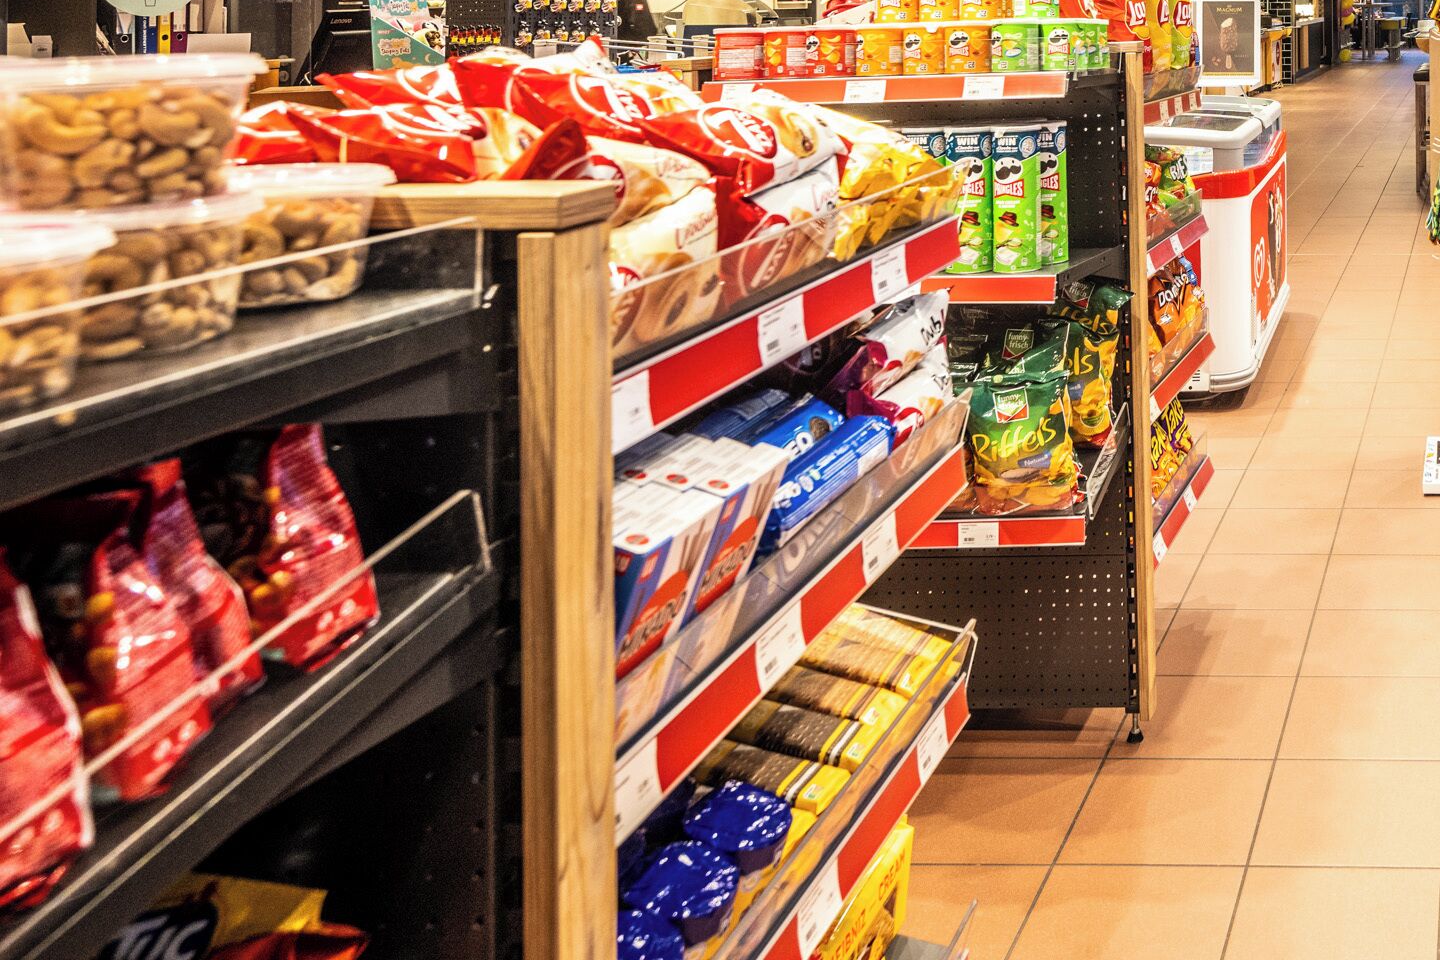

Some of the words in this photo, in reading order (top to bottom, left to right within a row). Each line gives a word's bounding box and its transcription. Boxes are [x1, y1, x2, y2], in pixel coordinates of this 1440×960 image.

[956, 136, 978, 145] WIN
[998, 136, 1017, 145] WIN
[994, 179, 1024, 198] PRINGLES
[1008, 331, 1030, 342] funny-
[1009, 339, 1029, 349] frisch
[997, 393, 1023, 404] funny-
[972, 417, 1057, 462] Riffels
[619, 591, 687, 660] MIKADO
[879, 848, 905, 901] CREAM
[107, 910, 209, 960] TUC
